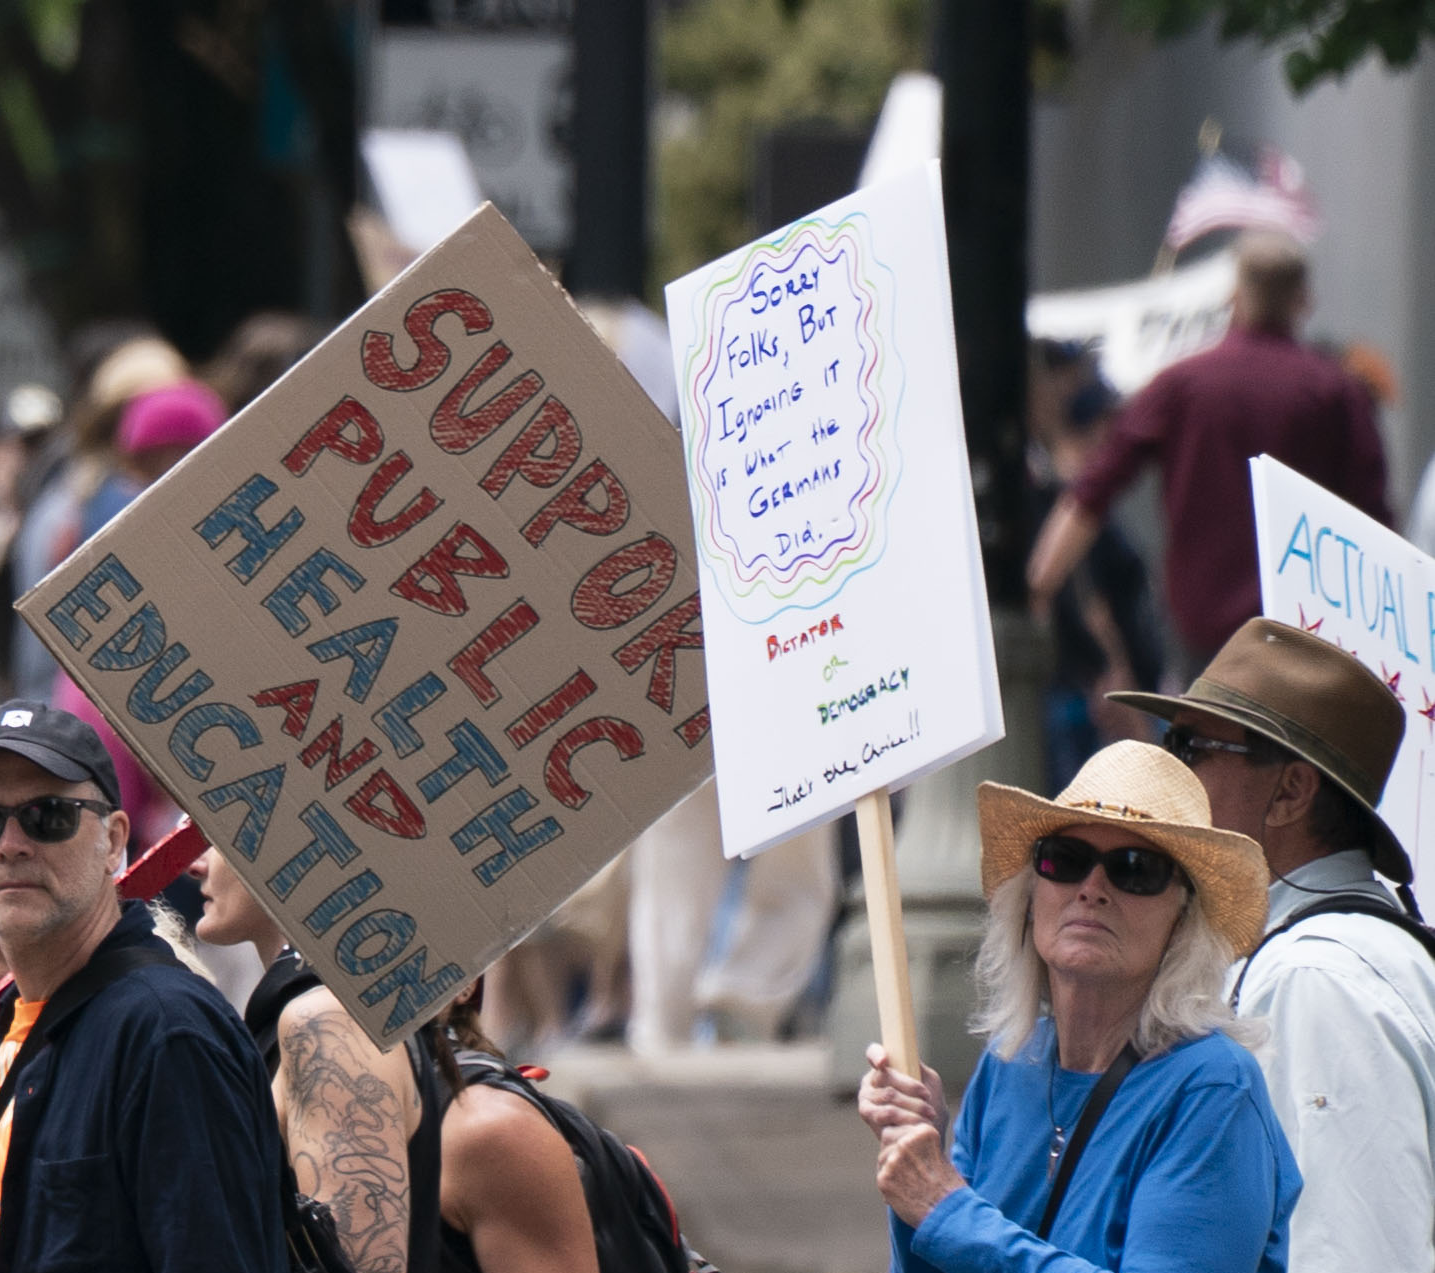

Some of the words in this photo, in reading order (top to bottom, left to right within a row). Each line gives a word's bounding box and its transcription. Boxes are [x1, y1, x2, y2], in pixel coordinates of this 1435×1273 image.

[360, 287, 716, 749] SUPPOR
[824, 359, 840, 388] IT
[45, 553, 465, 1035] EDUCATION
[193, 473, 564, 887] HEALTH
[247, 677, 427, 841] AND
[282, 395, 646, 811] PUBLIC
[1277, 512, 1419, 664] ACTUAL
